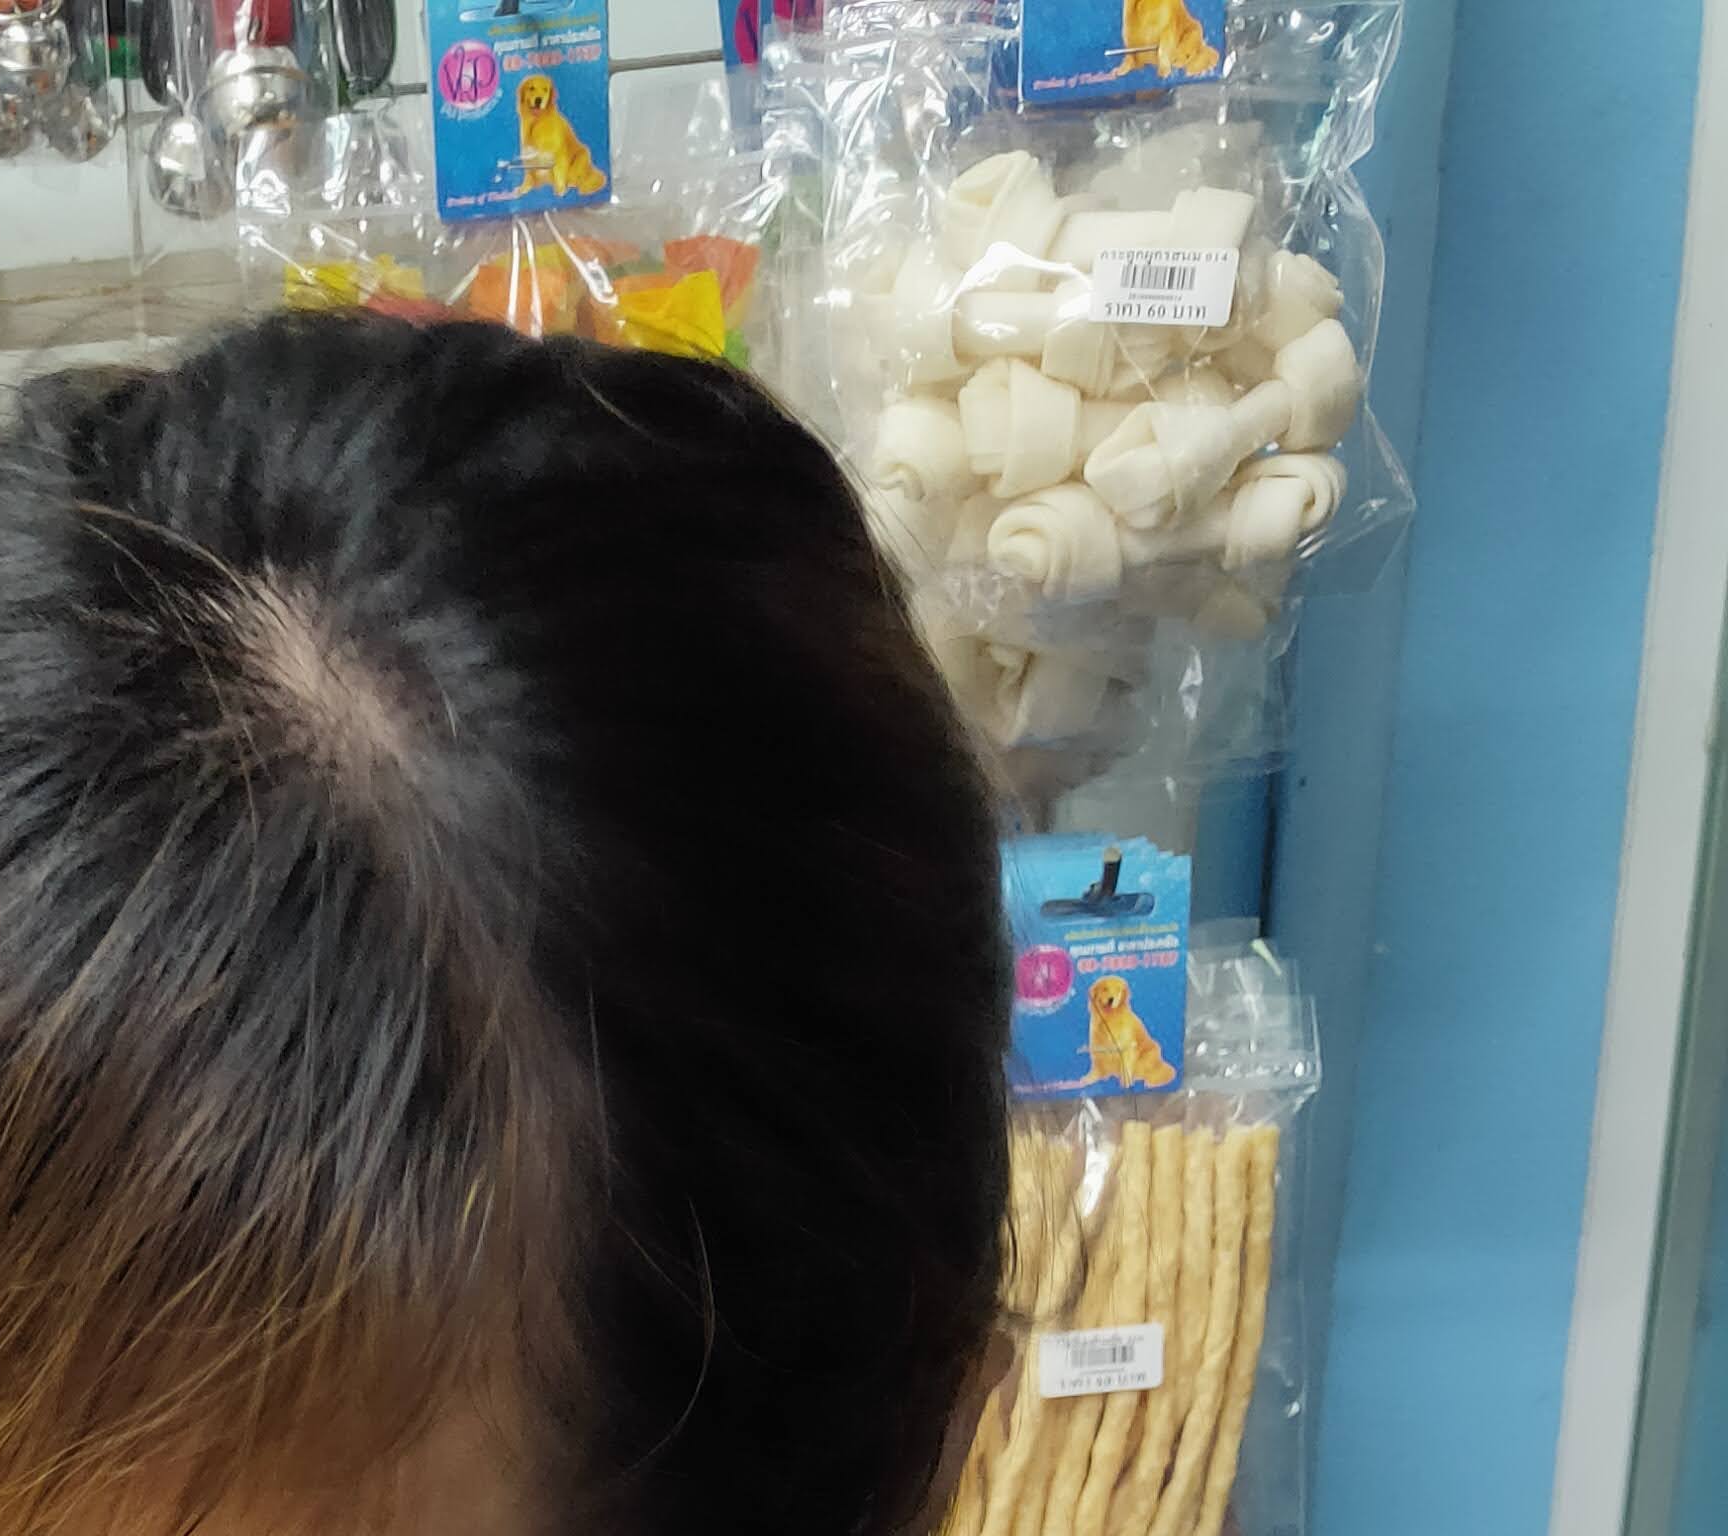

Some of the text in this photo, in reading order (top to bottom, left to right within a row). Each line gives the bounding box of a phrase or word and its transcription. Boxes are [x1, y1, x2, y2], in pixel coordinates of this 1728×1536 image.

[1104, 302, 1206, 320] ราคา 60 บาท
